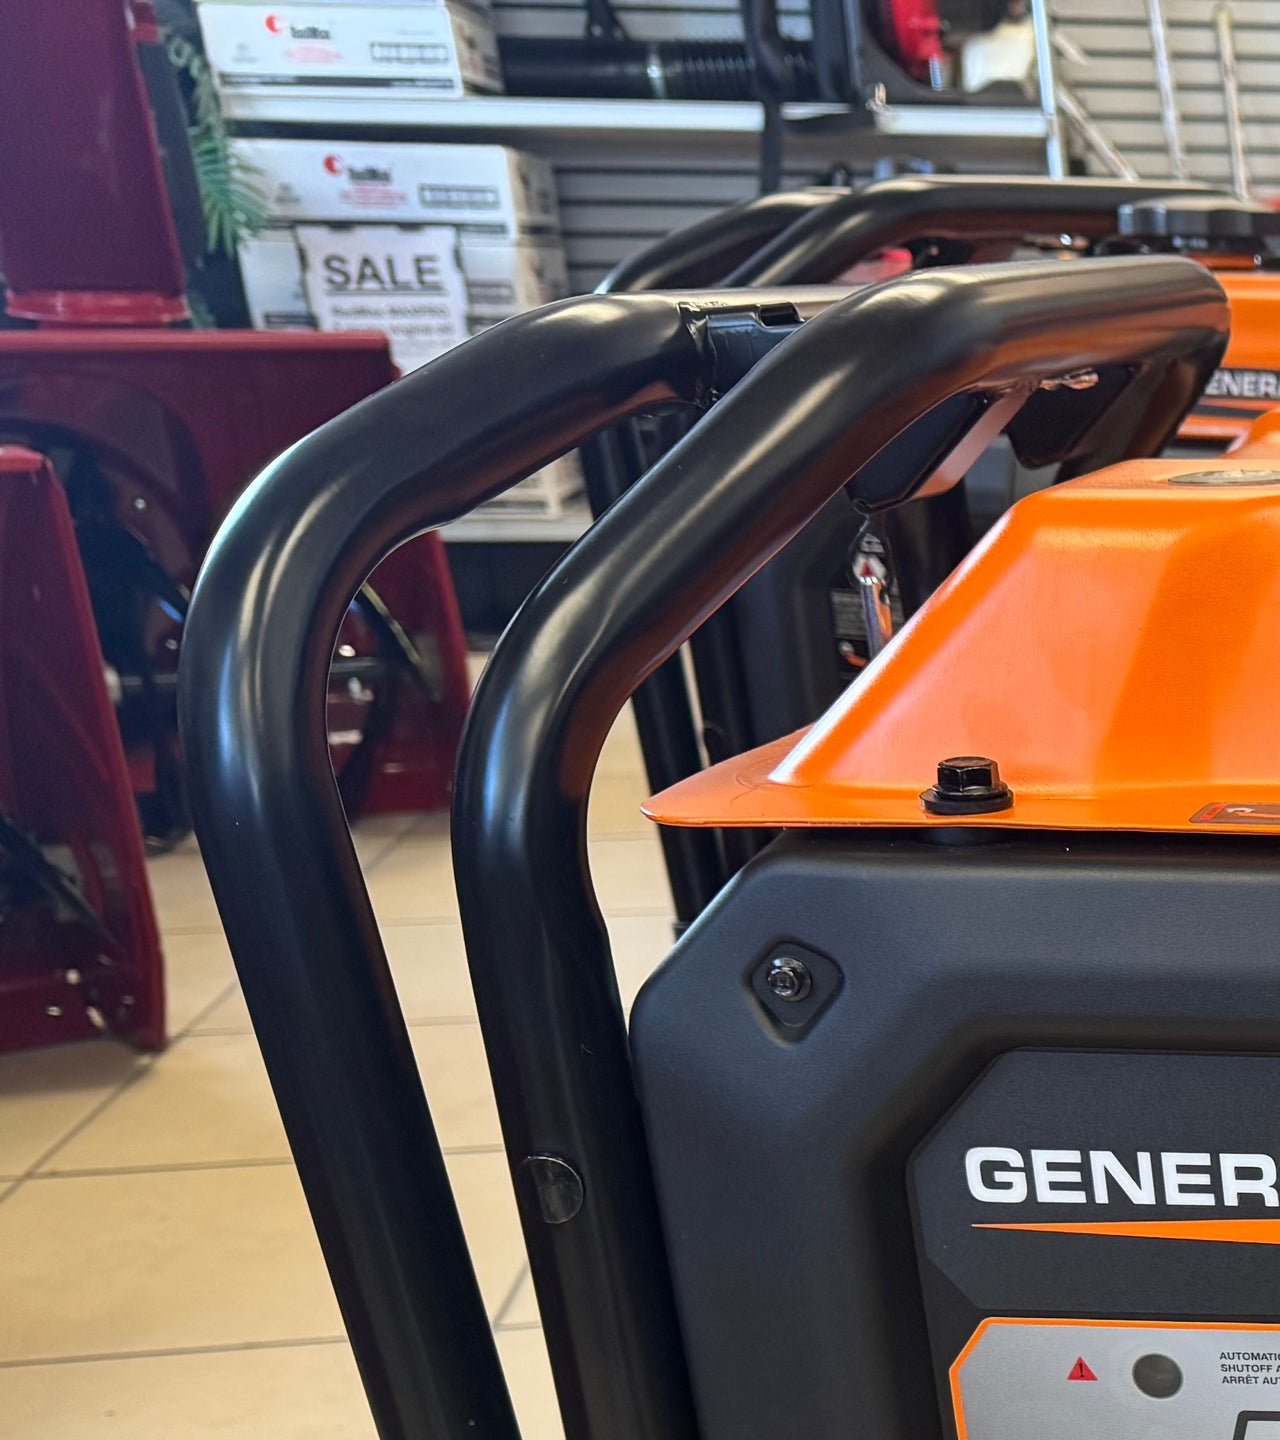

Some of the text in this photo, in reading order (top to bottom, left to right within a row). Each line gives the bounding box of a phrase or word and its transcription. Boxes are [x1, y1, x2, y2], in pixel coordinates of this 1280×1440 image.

[323, 255, 440, 289] SALE
[1220, 1363, 1273, 1373] SHUTOFF
[1222, 1373, 1259, 1385] ARRÊT
